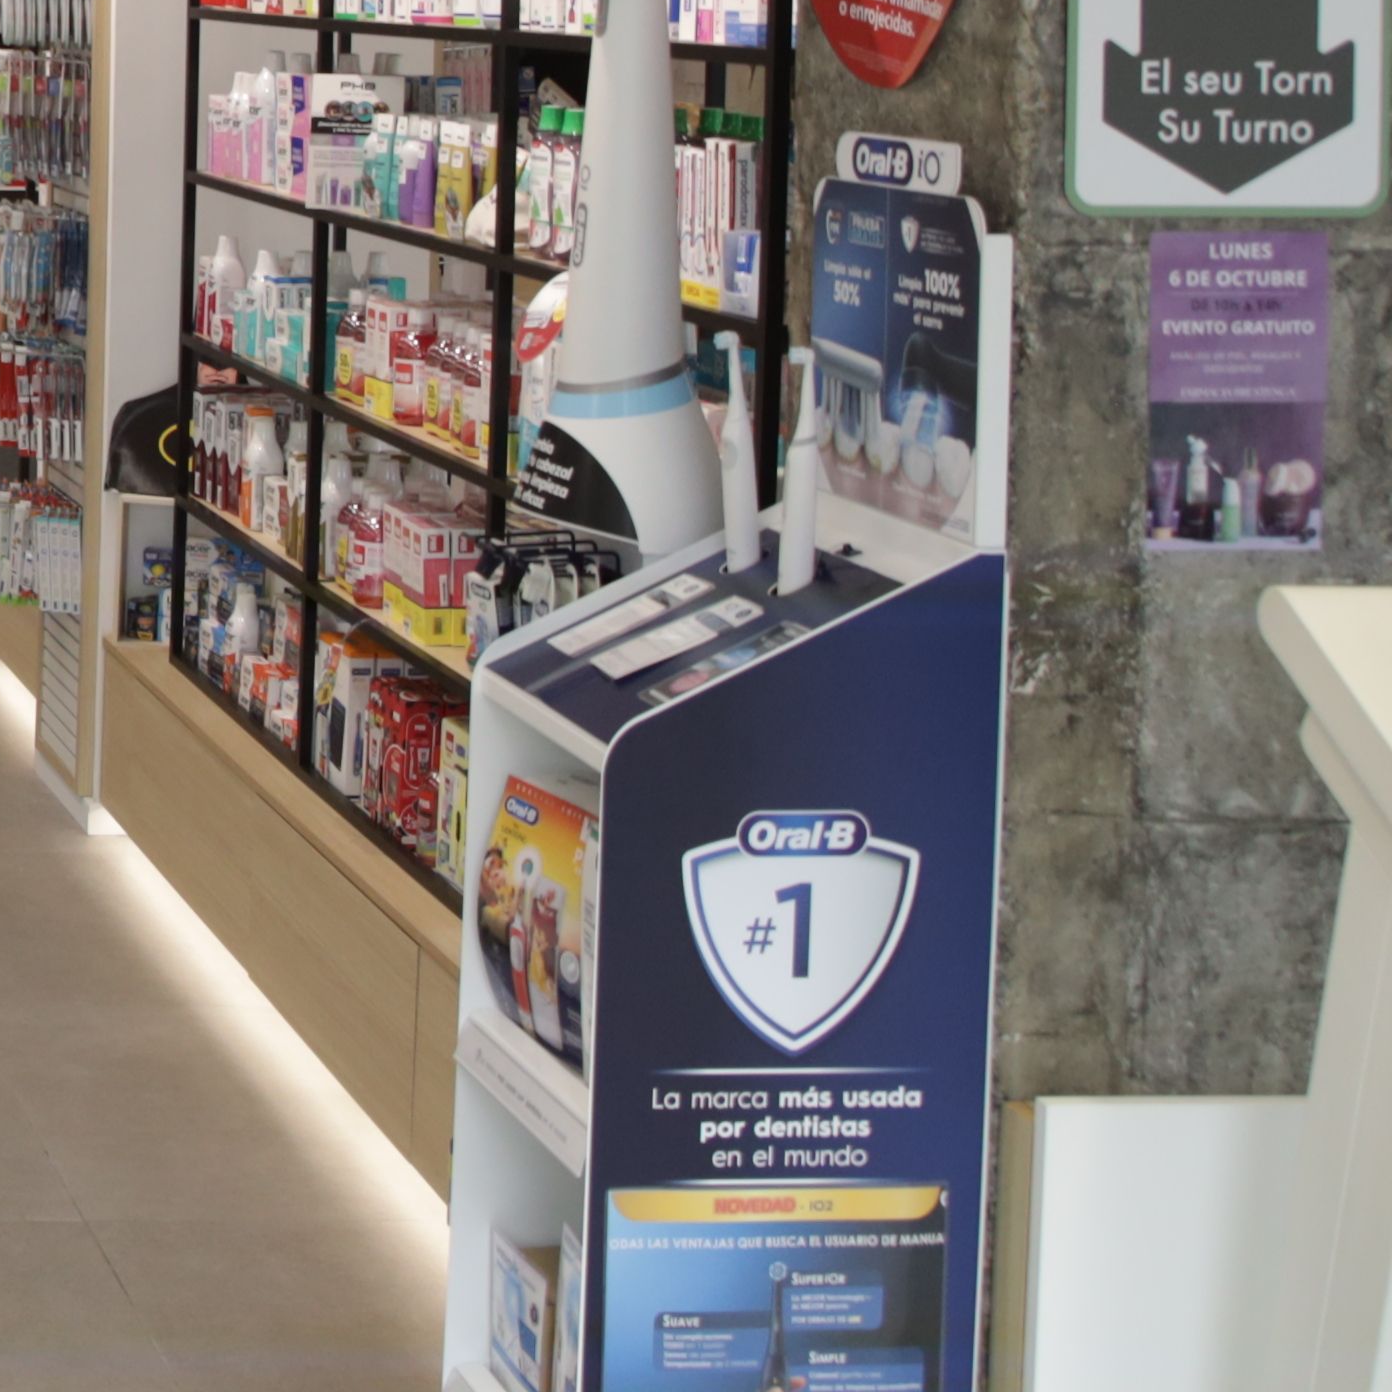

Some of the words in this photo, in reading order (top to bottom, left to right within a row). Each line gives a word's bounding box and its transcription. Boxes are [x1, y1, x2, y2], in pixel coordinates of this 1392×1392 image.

[839, 1, 847, 16] o
[850, 2, 915, 38] enrojecidas.
[1140, 60, 1171, 96] El
[1183, 67, 1244, 96] seu
[1255, 61, 1333, 96] Torn
[1157, 109, 1201, 144] Su
[1214, 111, 1314, 146] Turno
[855, 144, 909, 179] Oral-B
[1209, 242, 1273, 260] LUNES
[924, 268, 961, 300] 100%
[1169, 270, 1181, 287] 6
[1186, 270, 1211, 287] DE
[1216, 270, 1307, 287] OCTUBRE
[833, 279, 860, 306] 50%
[1161, 319, 1228, 335] EVENTO
[1231, 320, 1315, 335] GRATUITO
[747, 820, 857, 851] Oral-B
[652, 1088, 680, 1110] La
[691, 1091, 768, 1109] marca
[779, 1086, 832, 1109] más
[843, 1085, 923, 1109] usada
[700, 1119, 746, 1143] por
[753, 1115, 871, 1139] dentistas
[712, 1149, 742, 1168] en
[753, 1146, 774, 1168] el
[784, 1145, 869, 1168] mundo
[714, 1198, 796, 1214] NOVEDAD
[609, 1239, 644, 1250] ODAS
[647, 1238, 668, 1249] LAS
[673, 1237, 734, 1249] VENTAJAS
[737, 1237, 762, 1249] QUE
[765, 1235, 805, 1248] BUSCA
[809, 1236, 822, 1247] EL
[824, 1235, 878, 1247] USUARIO
[881, 1235, 897, 1246] DE
[899, 1233, 944, 1246] MANUA
